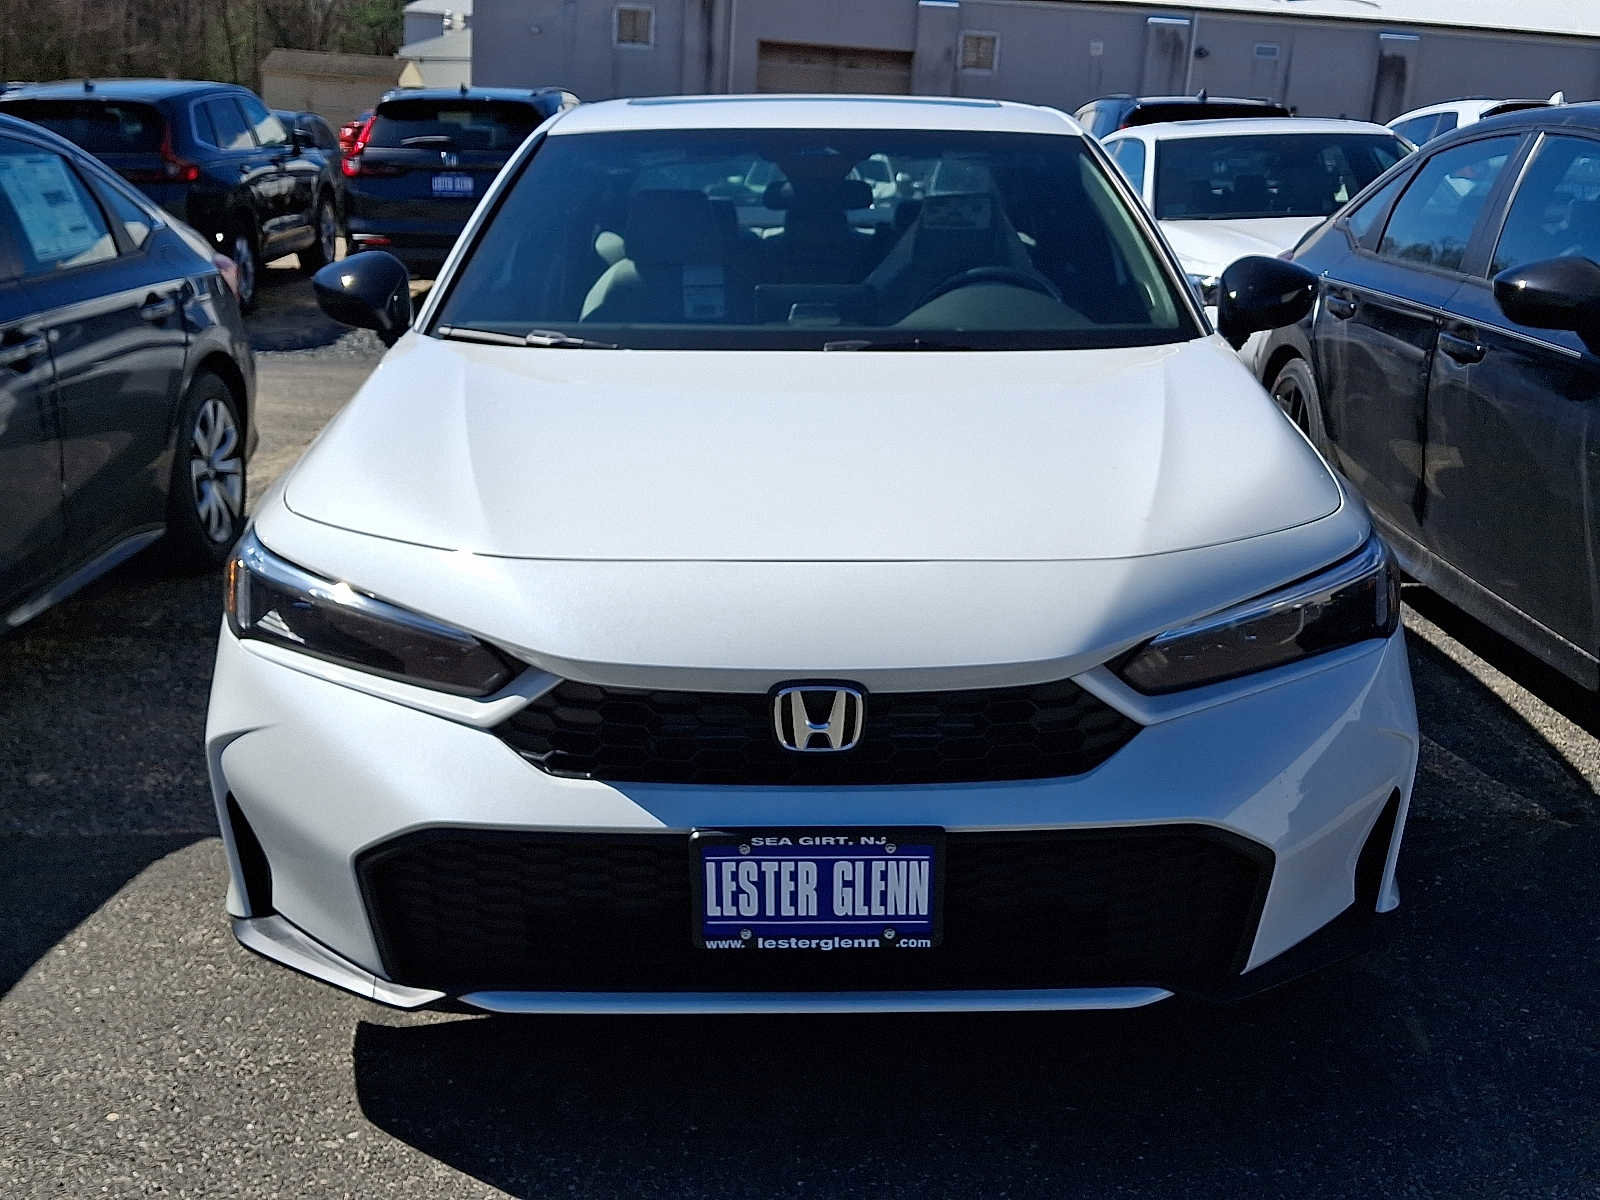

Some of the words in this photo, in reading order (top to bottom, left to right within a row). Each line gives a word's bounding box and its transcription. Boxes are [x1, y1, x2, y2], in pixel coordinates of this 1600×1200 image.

[751, 837, 792, 846] SEA
[860, 836, 887, 845] NJ
[705, 861, 818, 917] LESTER
[833, 860, 930, 916] GLENN
[757, 937, 881, 951] lesterglenn
